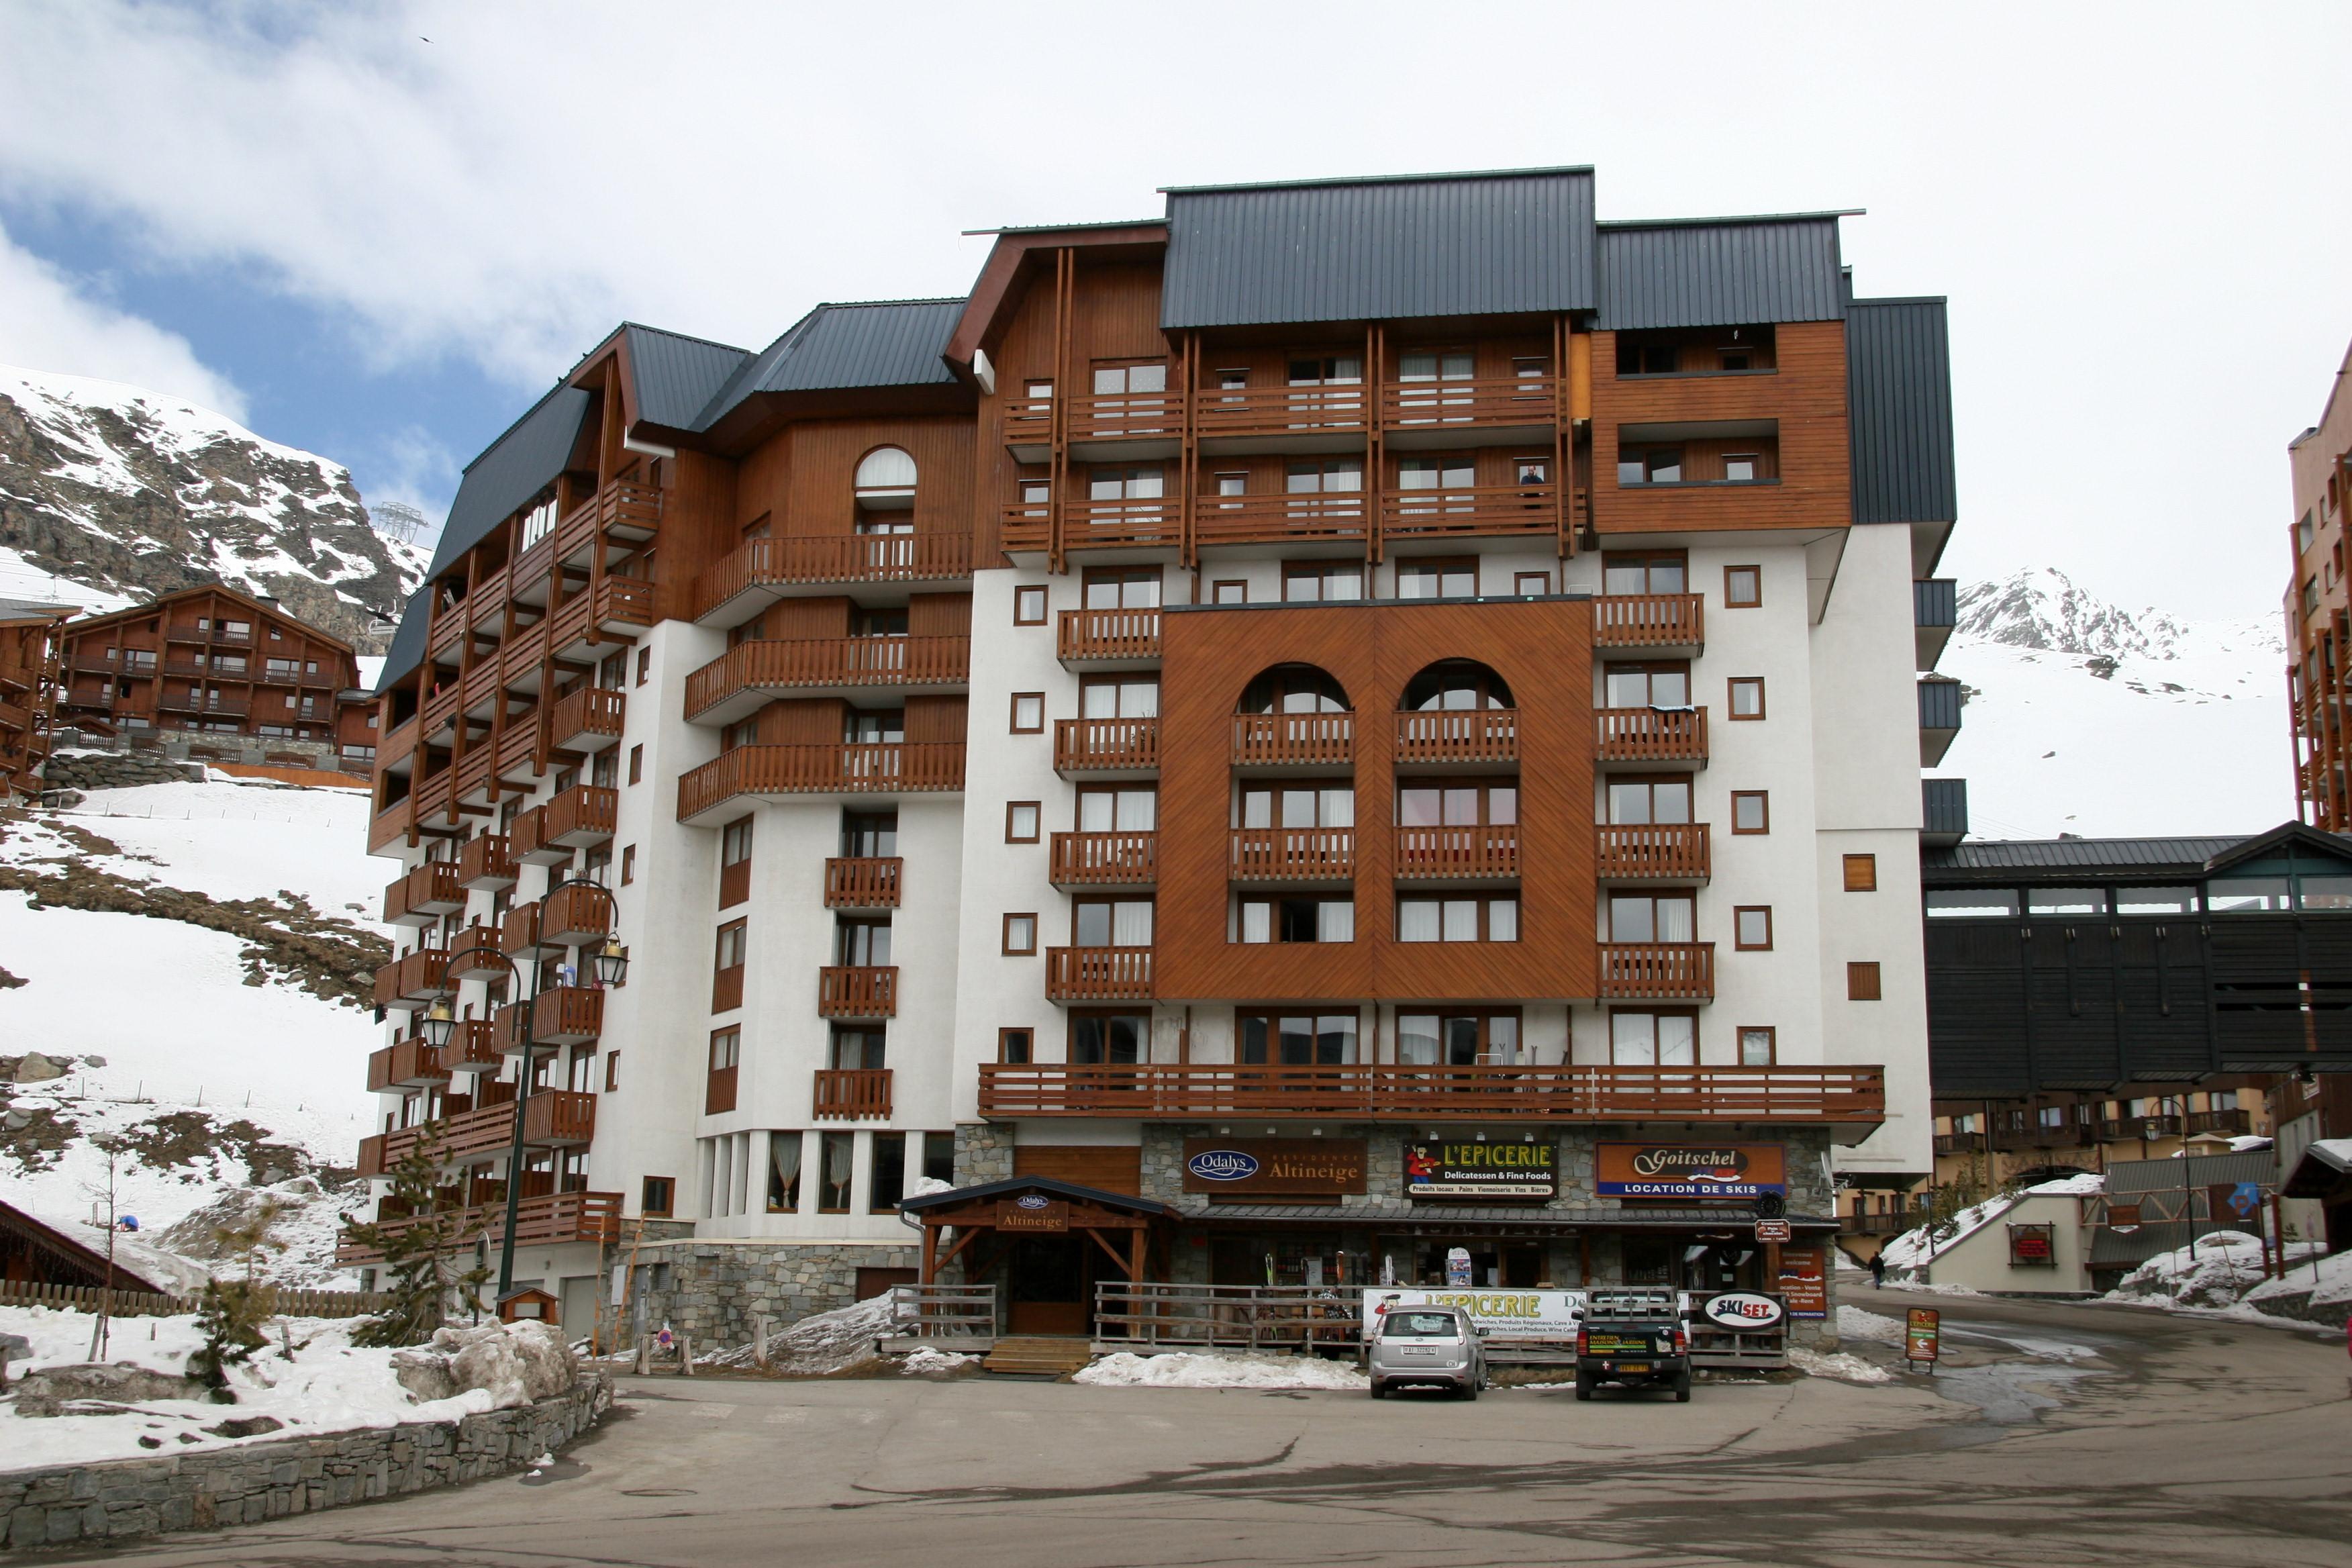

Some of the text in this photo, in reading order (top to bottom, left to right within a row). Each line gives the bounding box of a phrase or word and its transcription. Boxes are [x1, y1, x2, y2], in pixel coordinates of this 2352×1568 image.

[1201, 1154, 1246, 1174] Odalys
[1444, 1145, 1552, 1167] L'EPICERIE
[1634, 1149, 1736, 1175] Goitschel
[1269, 1162, 1358, 1183] Altineige
[1444, 1171, 1551, 1180] Delicatessen & Fine Foods
[1624, 1184, 1695, 1193] LOCATION
[1726, 1185, 1757, 1193] SKIS
[1022, 1196, 1044, 1205] Odalys
[1003, 1215, 1062, 1229] Altineige
